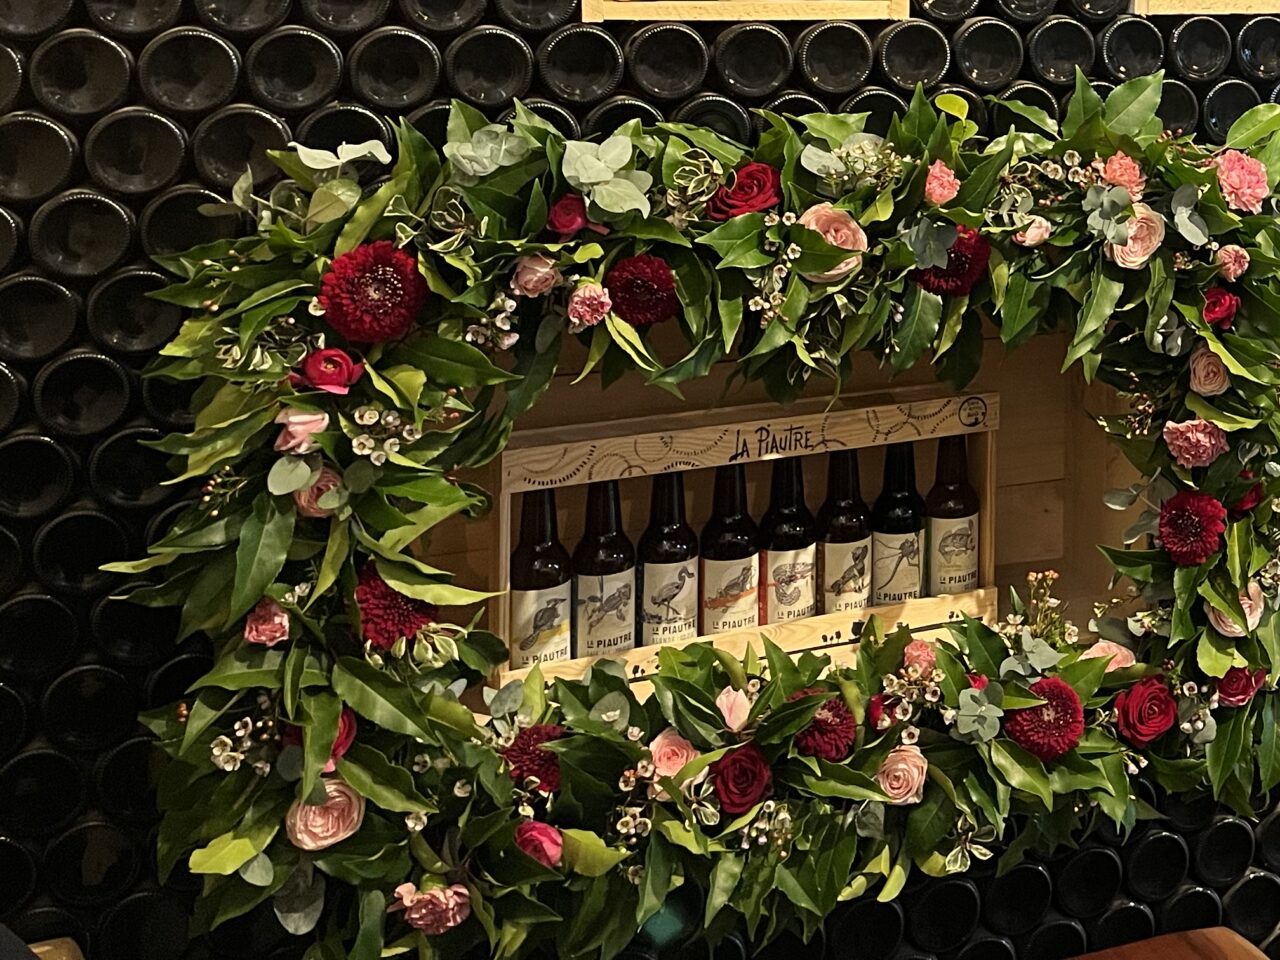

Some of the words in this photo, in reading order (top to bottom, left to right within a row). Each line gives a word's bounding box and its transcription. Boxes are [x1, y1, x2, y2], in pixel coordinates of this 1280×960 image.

[729, 429, 749, 462] LA
[755, 423, 814, 458] PIAUTRE
[884, 590, 918, 601] PIAUTRE
[662, 619, 695, 634] PIAUTRE
[722, 614, 755, 629] PIAUTRE
[597, 631, 632, 648] PIAUTRE
